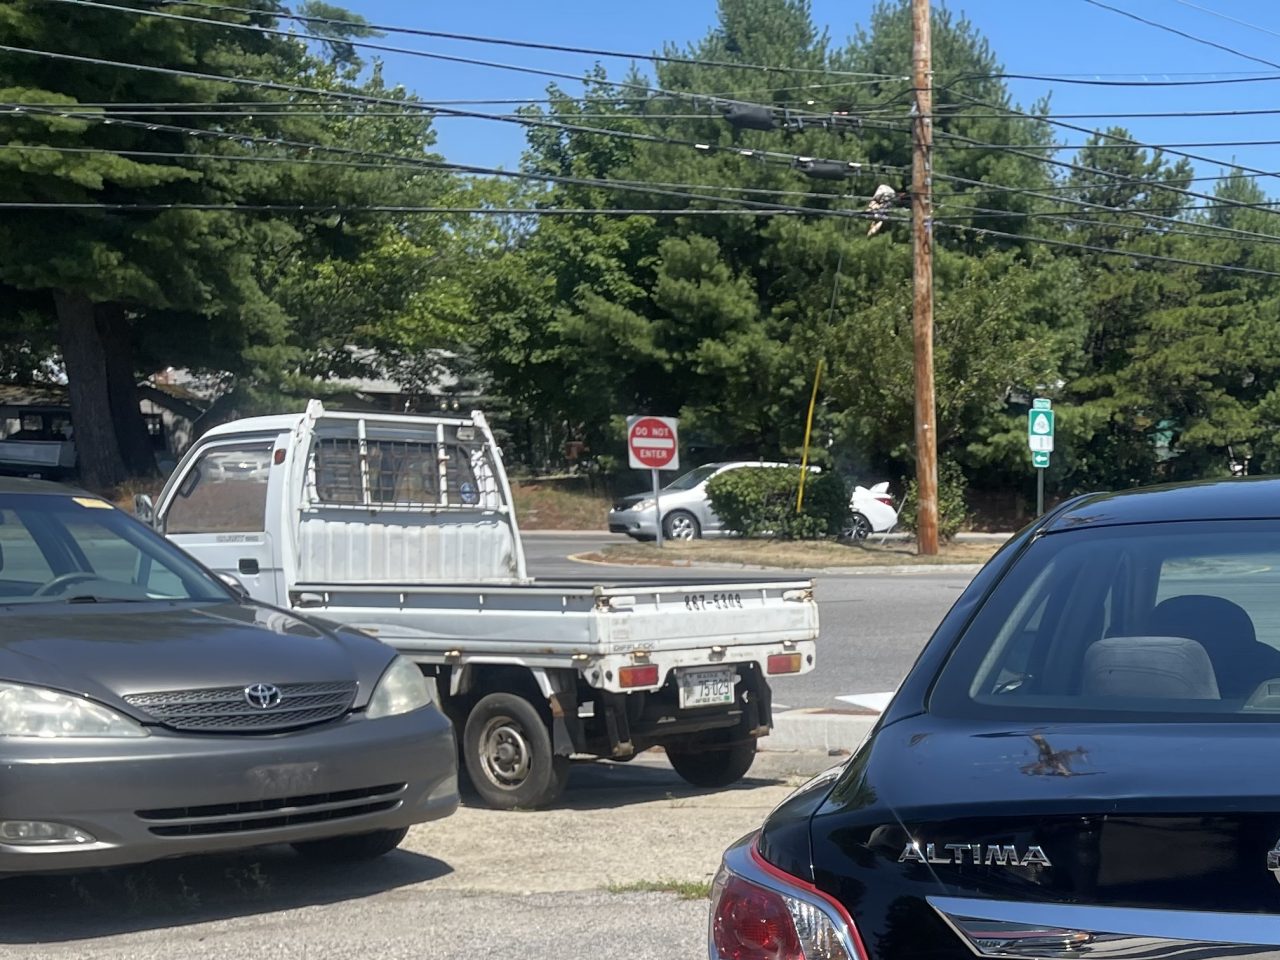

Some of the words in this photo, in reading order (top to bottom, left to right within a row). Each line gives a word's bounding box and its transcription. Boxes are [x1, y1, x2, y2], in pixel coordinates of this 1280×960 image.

[635, 426, 648, 436] DO
[652, 427, 669, 436] NOT
[640, 449, 667, 459] ENTER
[898, 842, 1053, 867] ALTIMA
